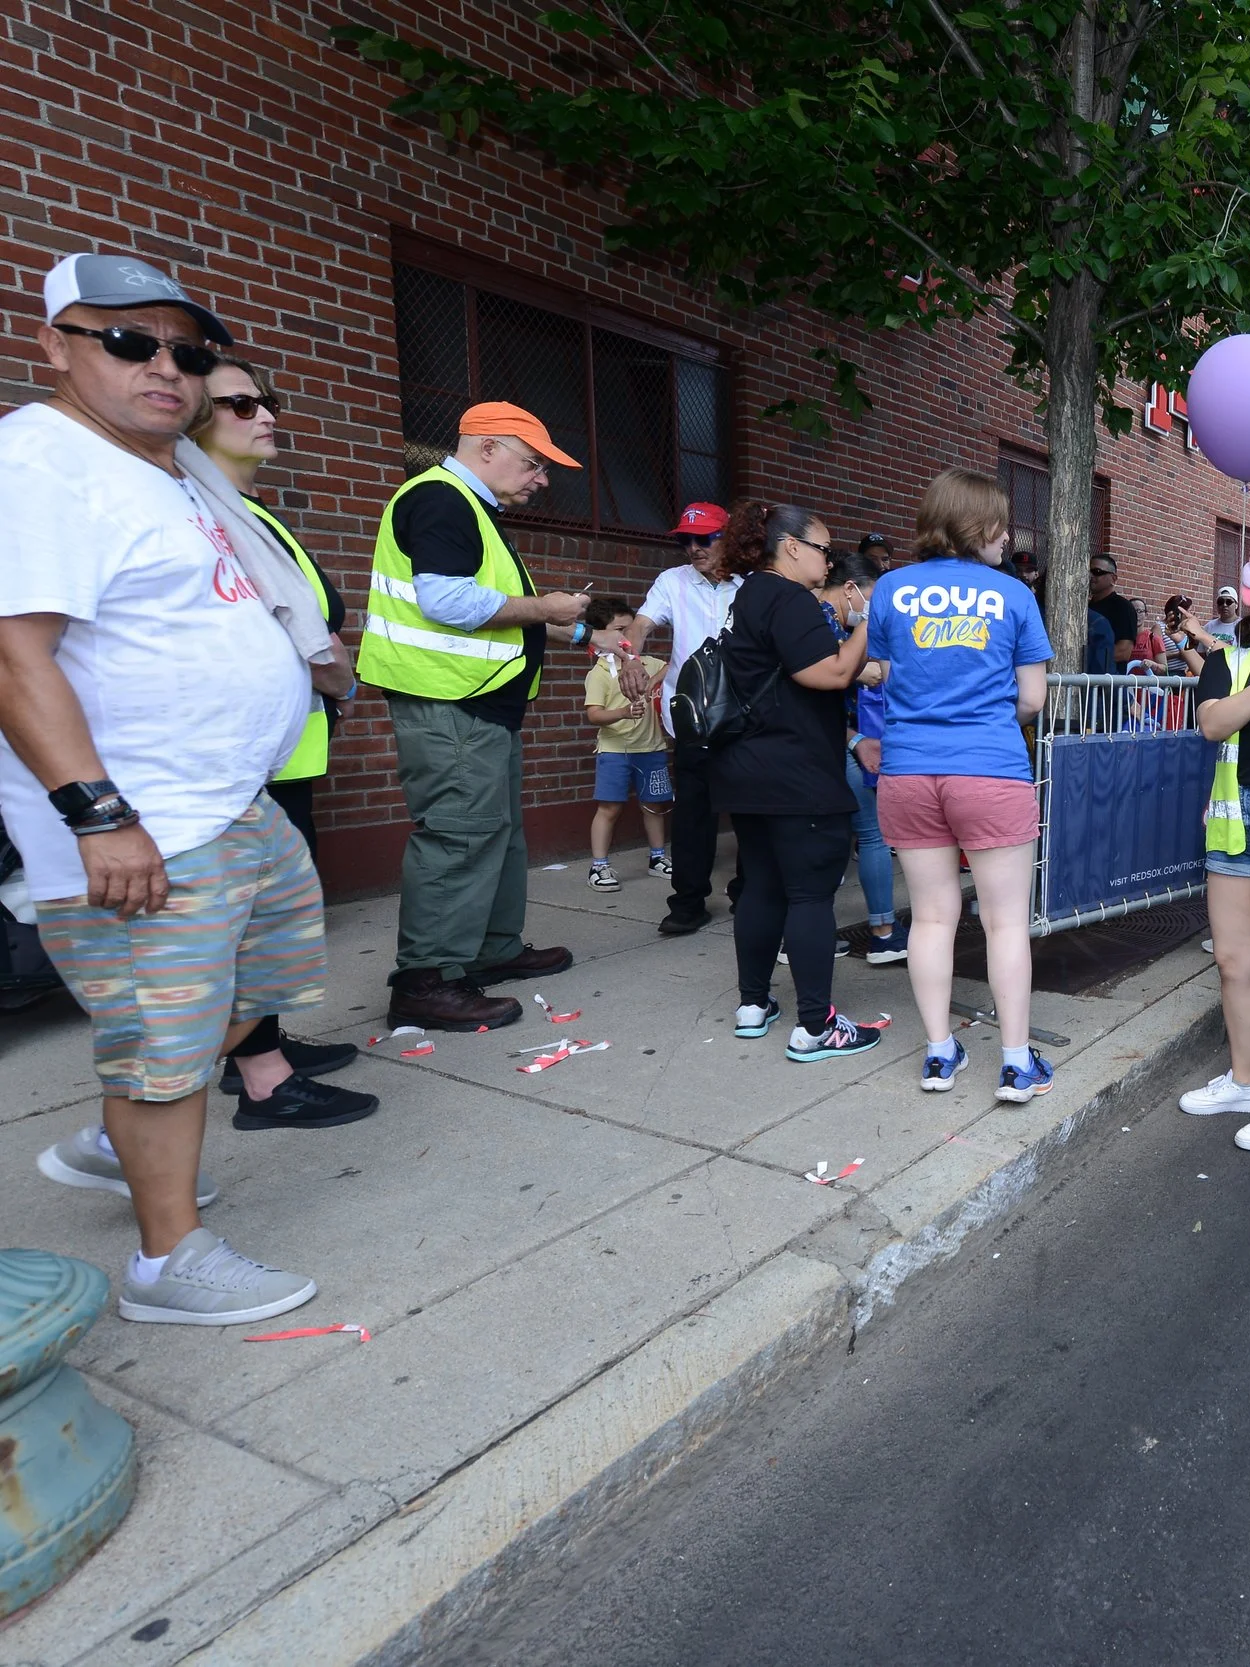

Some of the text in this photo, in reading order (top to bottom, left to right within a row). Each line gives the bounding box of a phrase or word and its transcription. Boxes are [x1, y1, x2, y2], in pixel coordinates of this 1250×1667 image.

[892, 585, 1005, 620] GOYA
[915, 611, 986, 657] gives
[1110, 877, 1128, 887] VISIT
